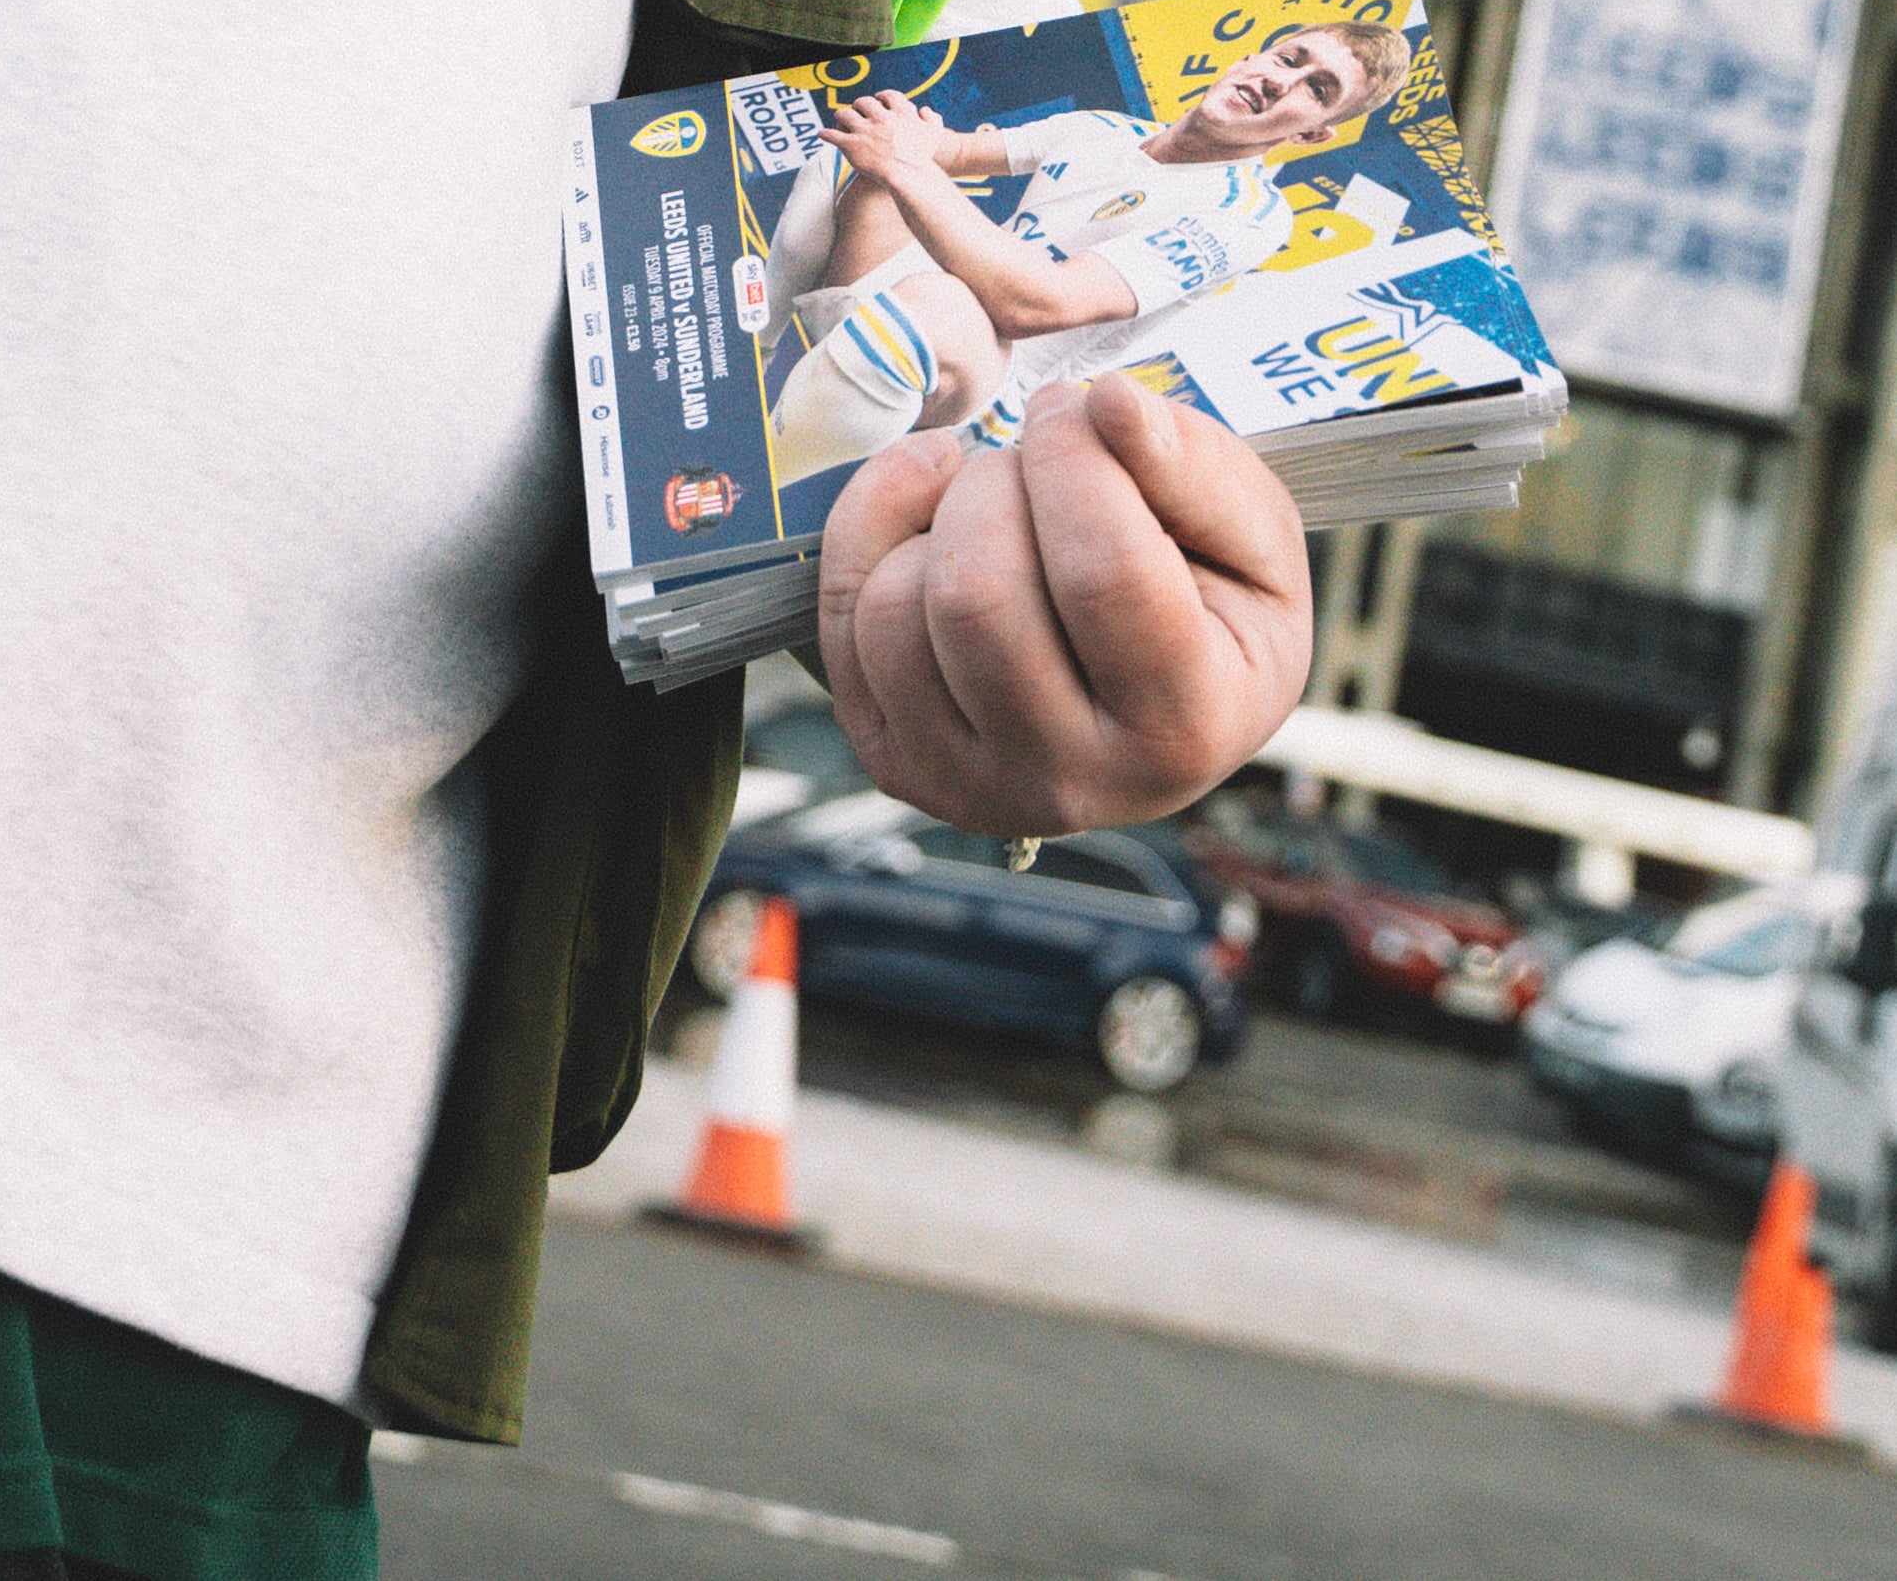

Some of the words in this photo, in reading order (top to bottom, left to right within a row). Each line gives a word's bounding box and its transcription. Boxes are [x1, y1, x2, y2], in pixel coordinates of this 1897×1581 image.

[739, 91, 789, 154] ROAD
[774, 84, 824, 160] ELLAN
[572, 139, 585, 168] BOXT
[660, 190, 689, 240] LEEDS
[644, 244, 663, 288] TUESDAY
[696, 224, 715, 266] OFFICIAL
[1144, 229, 1205, 290] LAND
[665, 240, 694, 301] UNITED
[702, 266, 720, 315] MATCHDAY
[747, 263, 759, 280] sky
[622, 283, 637, 306] ISSUE
[624, 306, 638, 318] 23
[648, 288, 663, 296] 9
[648, 296, 666, 322] APRIL
[672, 302, 691, 314] v
[626, 324, 641, 352] £3.50
[652, 322, 669, 350] 2024
[706, 314, 729, 380] PROGRAMME
[653, 357, 671, 381] 8pm
[673, 314, 709, 430] SUNDERLAND
[1251, 342, 1335, 405] WE
